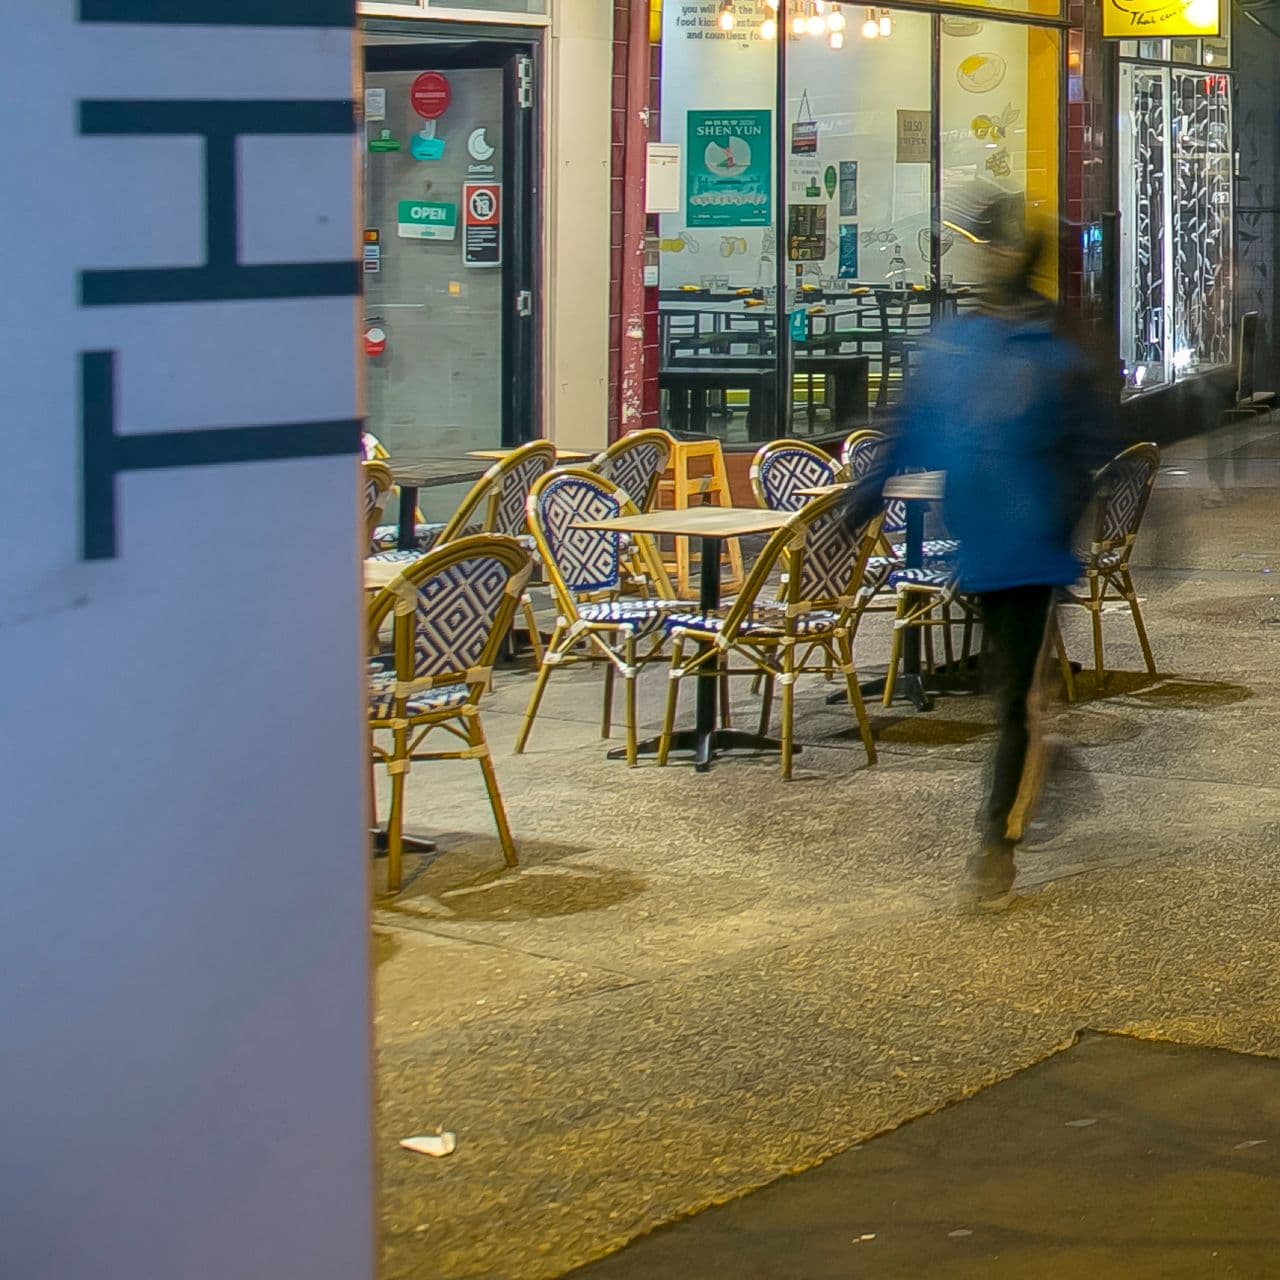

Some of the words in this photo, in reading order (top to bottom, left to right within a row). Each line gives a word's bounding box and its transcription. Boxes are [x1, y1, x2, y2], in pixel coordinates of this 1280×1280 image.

[696, 126, 732, 136] SHEN
[735, 125, 762, 136] YUN
[410, 206, 447, 220] OPEN
